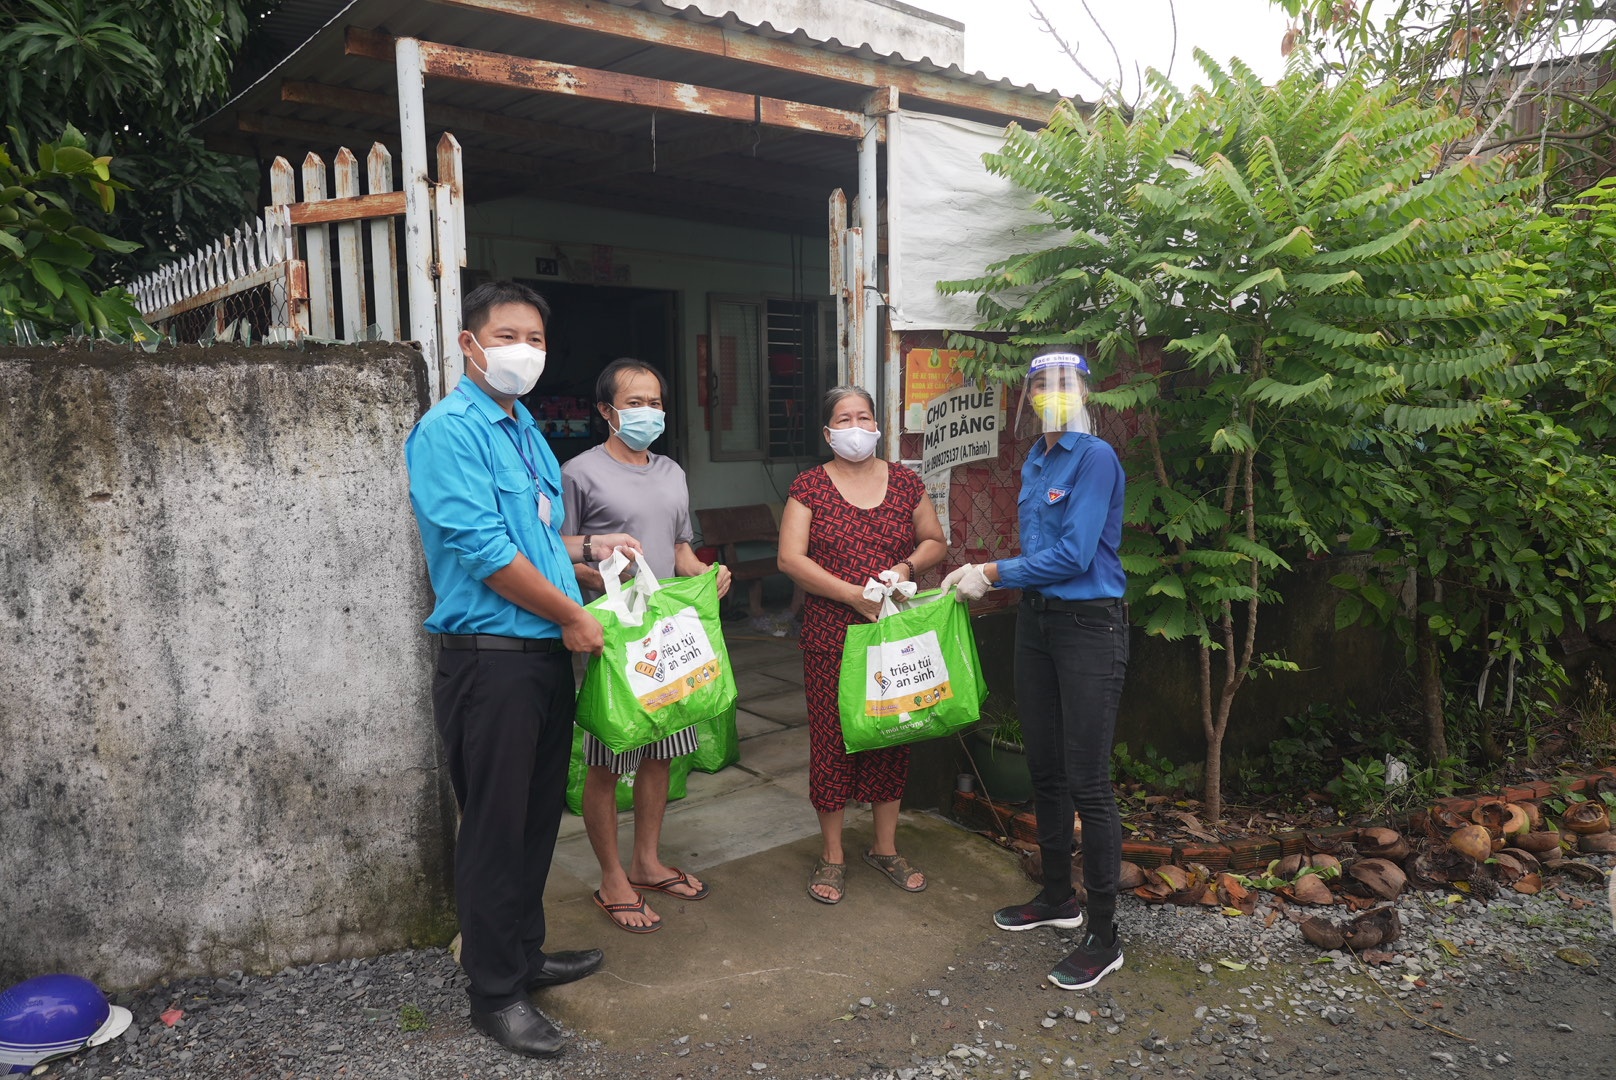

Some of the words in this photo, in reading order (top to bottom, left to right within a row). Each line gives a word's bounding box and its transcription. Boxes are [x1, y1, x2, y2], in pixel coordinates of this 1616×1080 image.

[926, 400, 947, 425] CHO
[949, 386, 995, 413] THUÊ
[924, 423, 947, 451] MẶT
[950, 414, 995, 438] BẰNG
[661, 643, 682, 660] riệu
[681, 632, 696, 648] túi
[668, 659, 679, 671] an
[680, 645, 702, 664] sinh
[890, 662, 917, 677] triệu
[918, 655, 932, 669] túi
[896, 677, 911, 688] an
[913, 668, 935, 684] sinh
